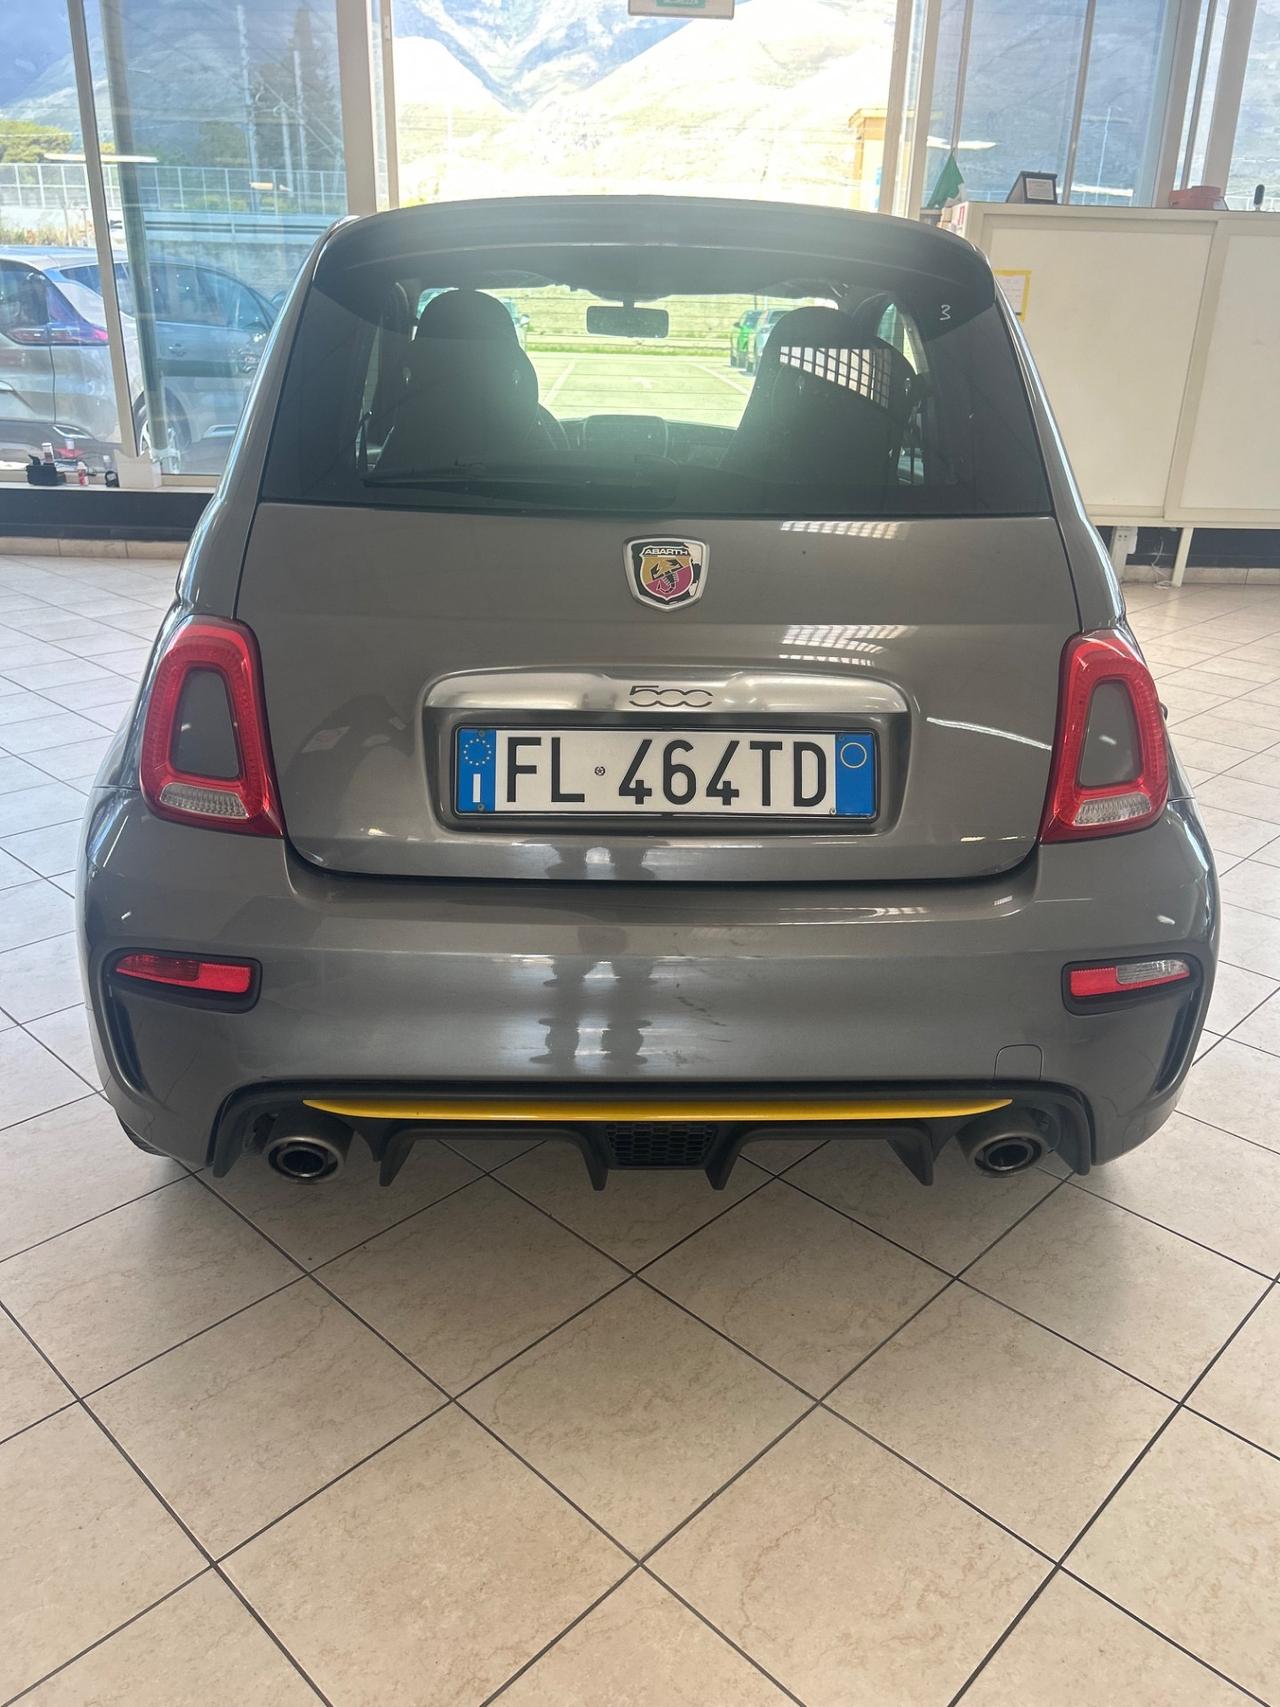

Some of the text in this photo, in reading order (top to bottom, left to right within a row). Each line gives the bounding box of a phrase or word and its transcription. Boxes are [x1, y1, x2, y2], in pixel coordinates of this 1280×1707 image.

[940, 304, 951, 320] 3
[629, 685, 714, 708] 500
[507, 736, 827, 807] FL 464TD
